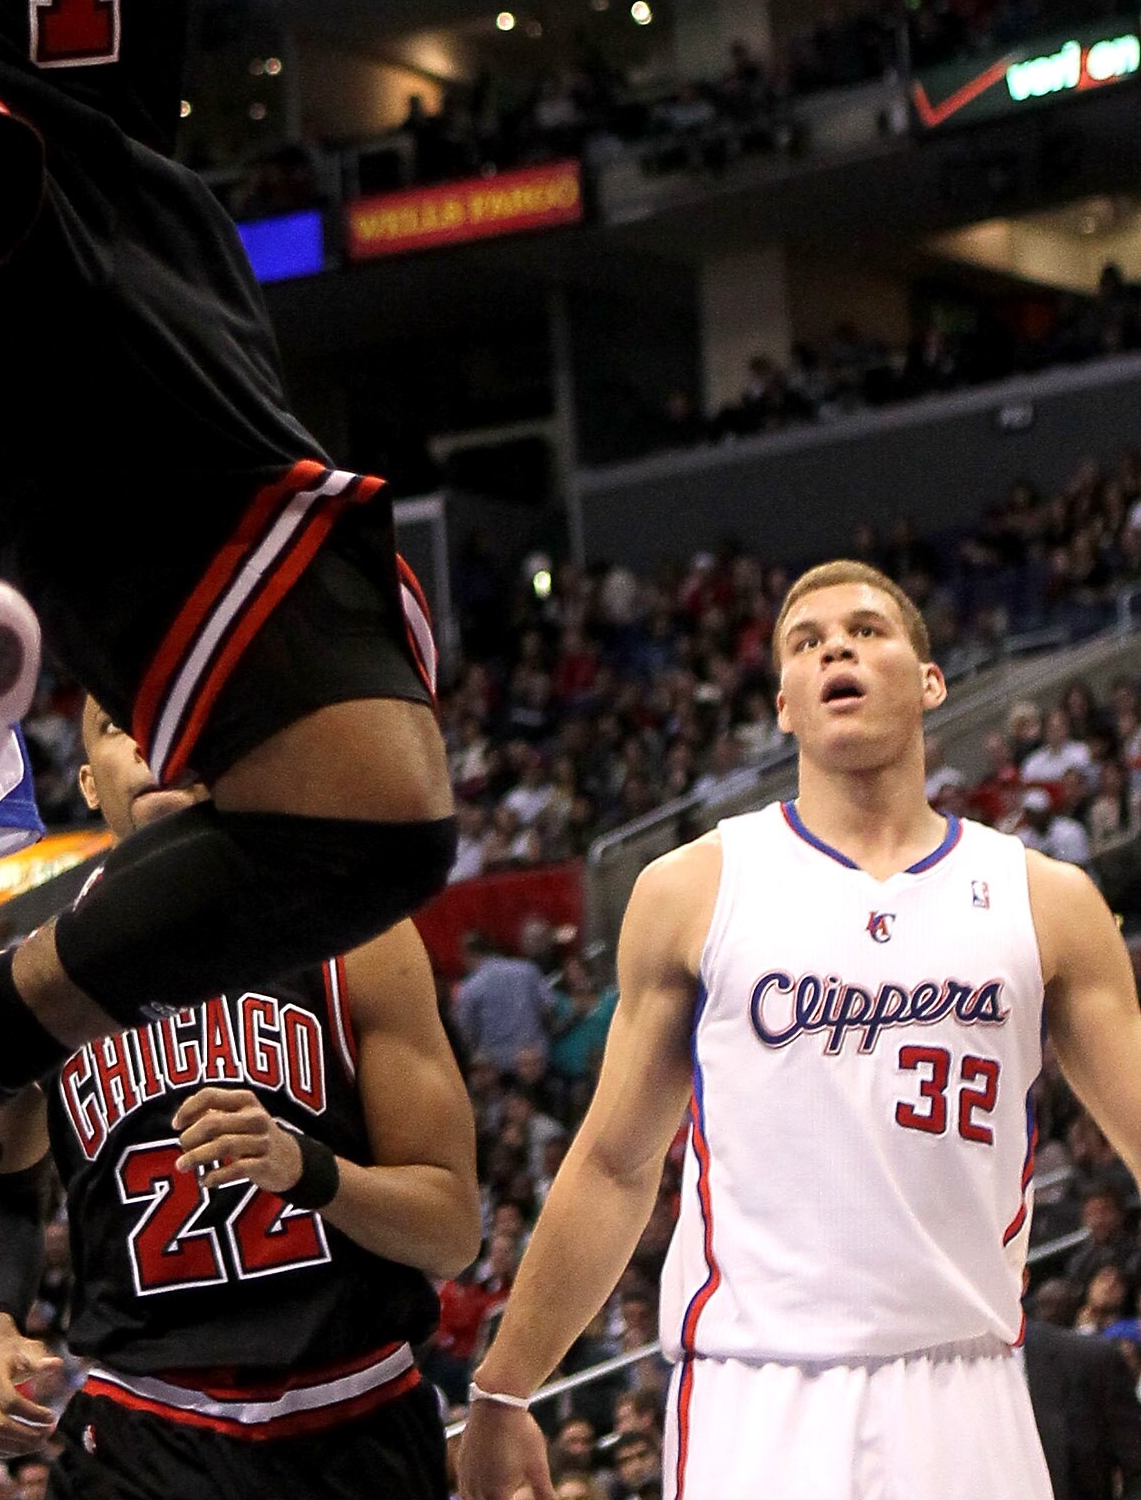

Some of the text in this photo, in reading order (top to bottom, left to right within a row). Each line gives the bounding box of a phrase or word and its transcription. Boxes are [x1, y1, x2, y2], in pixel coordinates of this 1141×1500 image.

[59, 991, 327, 1162] CHICAGO
[747, 968, 1013, 1056] Clippers
[894, 1043, 1003, 1147] 32
[114, 1116, 333, 1297] 22
